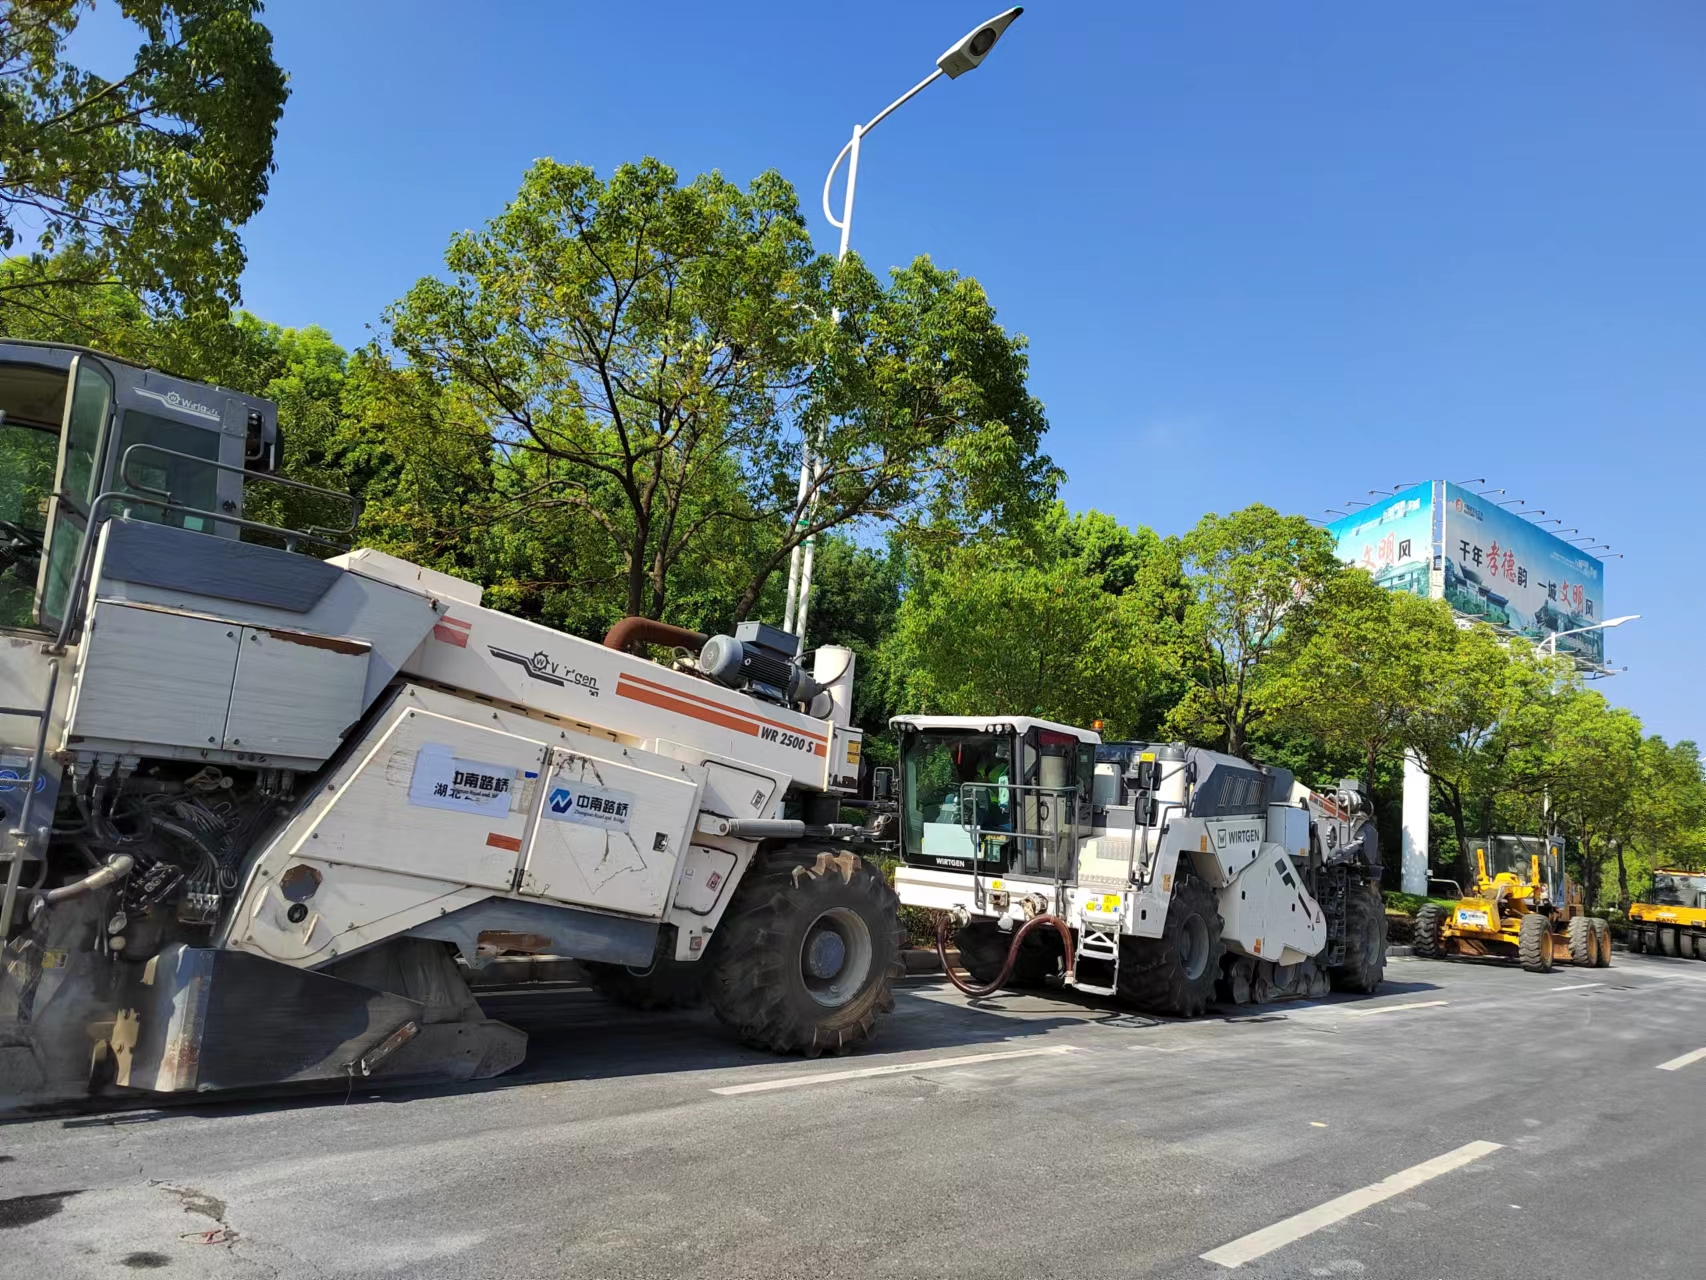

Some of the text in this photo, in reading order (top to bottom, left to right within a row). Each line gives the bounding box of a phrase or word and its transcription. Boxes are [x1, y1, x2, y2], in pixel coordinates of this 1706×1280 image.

[1460, 539, 1527, 588] 千年孝德韵
[1537, 579, 1593, 618] 一城文明风
[760, 726, 814, 753] WR 2500 S
[576, 794, 629, 817] 中南路桥
[1228, 829, 1260, 844] WIRTGEN
[935, 857, 965, 867] WIRTGEN
